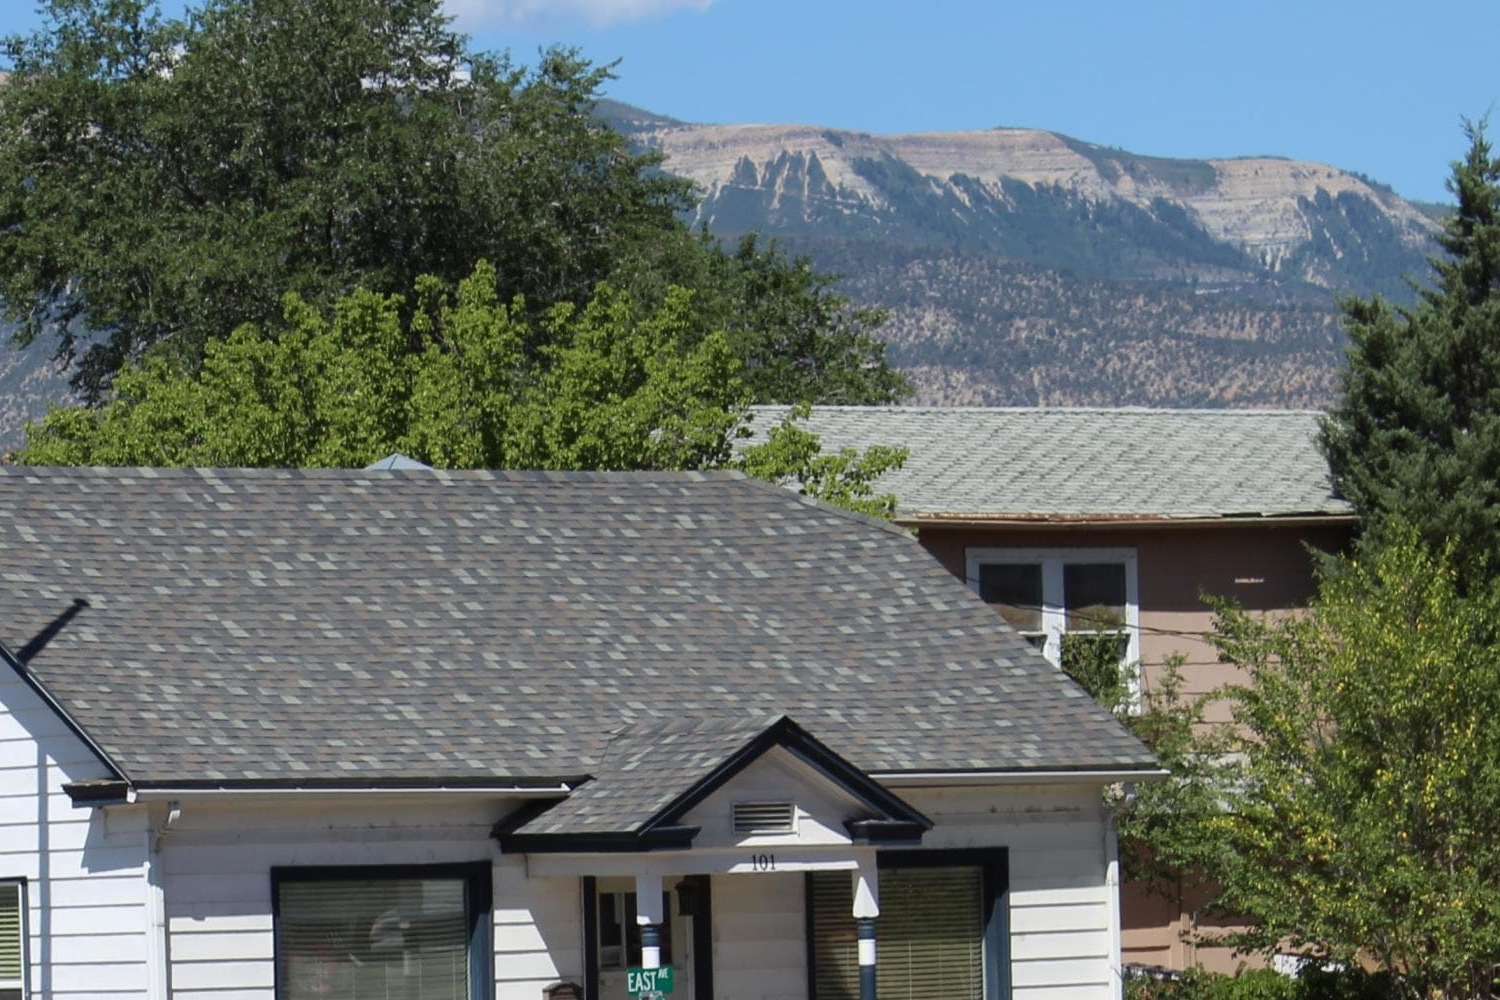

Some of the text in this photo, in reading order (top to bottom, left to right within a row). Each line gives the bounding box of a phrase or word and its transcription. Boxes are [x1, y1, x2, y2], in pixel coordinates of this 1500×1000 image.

[752, 854, 776, 871] 101
[627, 968, 669, 992] EAST AVE
